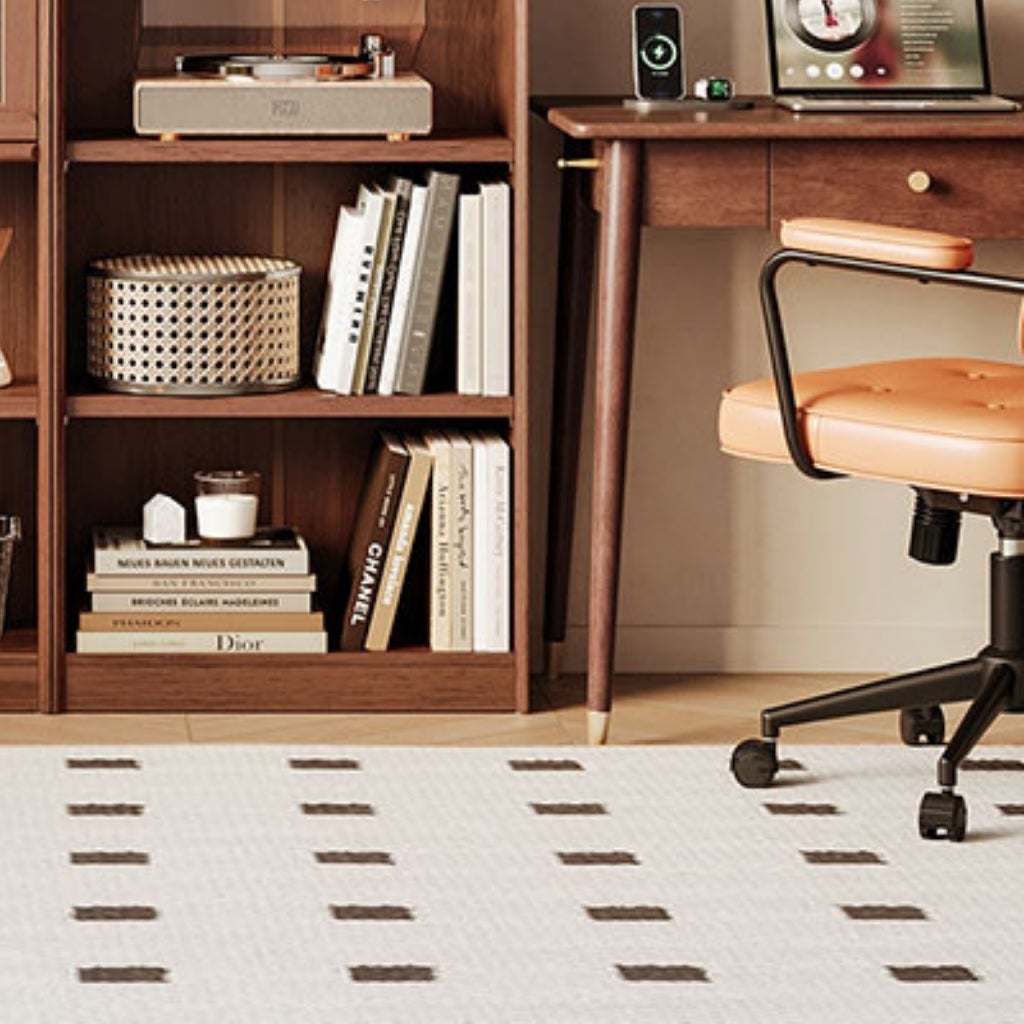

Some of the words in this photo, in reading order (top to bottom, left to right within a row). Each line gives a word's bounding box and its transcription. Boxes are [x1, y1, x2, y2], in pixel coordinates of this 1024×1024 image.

[117, 558, 151, 568] NEUES
[154, 558, 190, 568] BAUEN
[192, 558, 226, 568] NEUES
[229, 558, 285, 568] GESTALTEN
[350, 541, 383, 626] CHANEL
[216, 634, 264, 651] Dior
